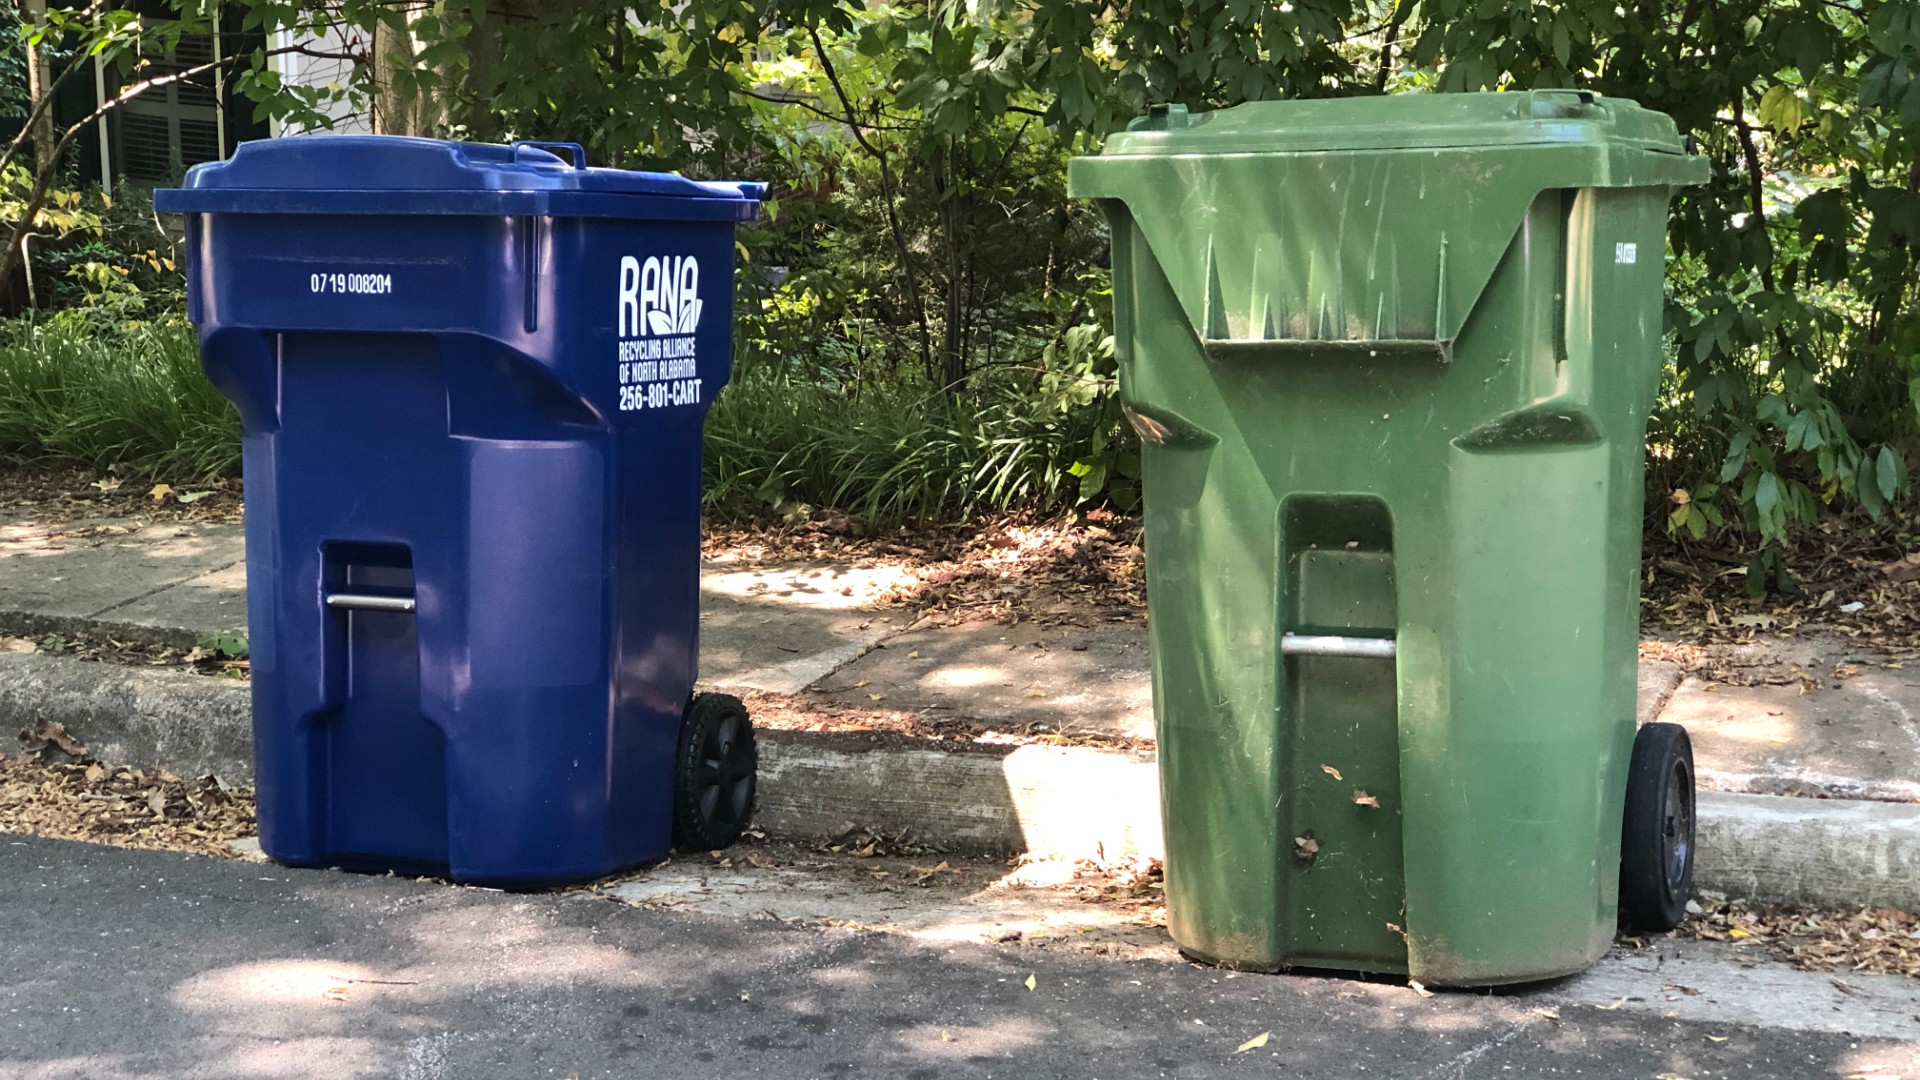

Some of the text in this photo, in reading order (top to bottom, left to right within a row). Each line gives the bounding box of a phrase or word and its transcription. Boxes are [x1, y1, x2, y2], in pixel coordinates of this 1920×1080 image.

[619, 255, 699, 337] RANA
[619, 337, 695, 361] RECYCLING ALLIANCE
[619, 358, 696, 384] OF NORTH ALABAMA
[619, 379, 702, 411] 256-801-CART
